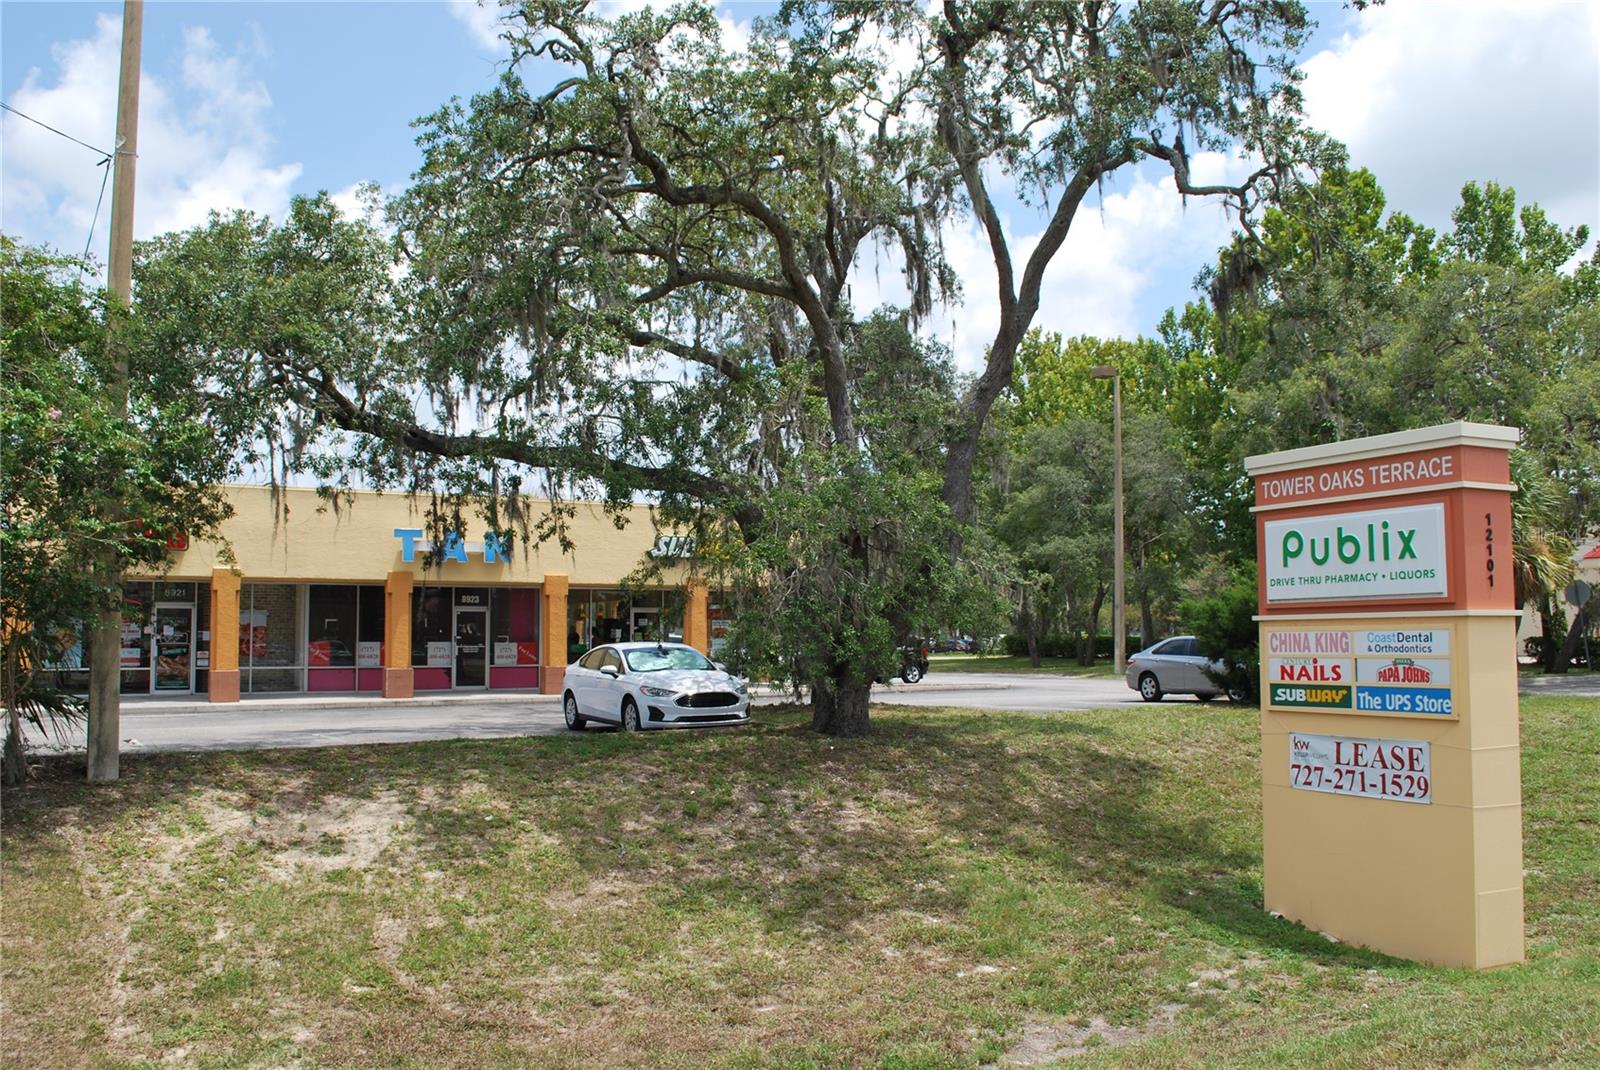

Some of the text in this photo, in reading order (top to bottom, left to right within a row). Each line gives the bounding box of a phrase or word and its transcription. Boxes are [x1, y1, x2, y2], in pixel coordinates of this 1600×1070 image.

[1262, 455, 1453, 499] TOWER OAKS TERRACE
[393, 528, 512, 563] TAN
[1282, 519, 1418, 568] Publix
[1484, 512, 1495, 588] 12101
[1270, 568, 1436, 587] DRIVE THRU PHARMACY LIQUORS
[1270, 632, 1350, 653] CHINA KING
[1374, 644, 1433, 653] Orthodontics
[1378, 664, 1431, 684] PAPA JOHNS
[1274, 688, 1347, 704] SUBWAY
[1358, 692, 1451, 713] The UPS Store
[1334, 741, 1425, 772] LEASE
[1291, 764, 1429, 799] 727-271-1529
